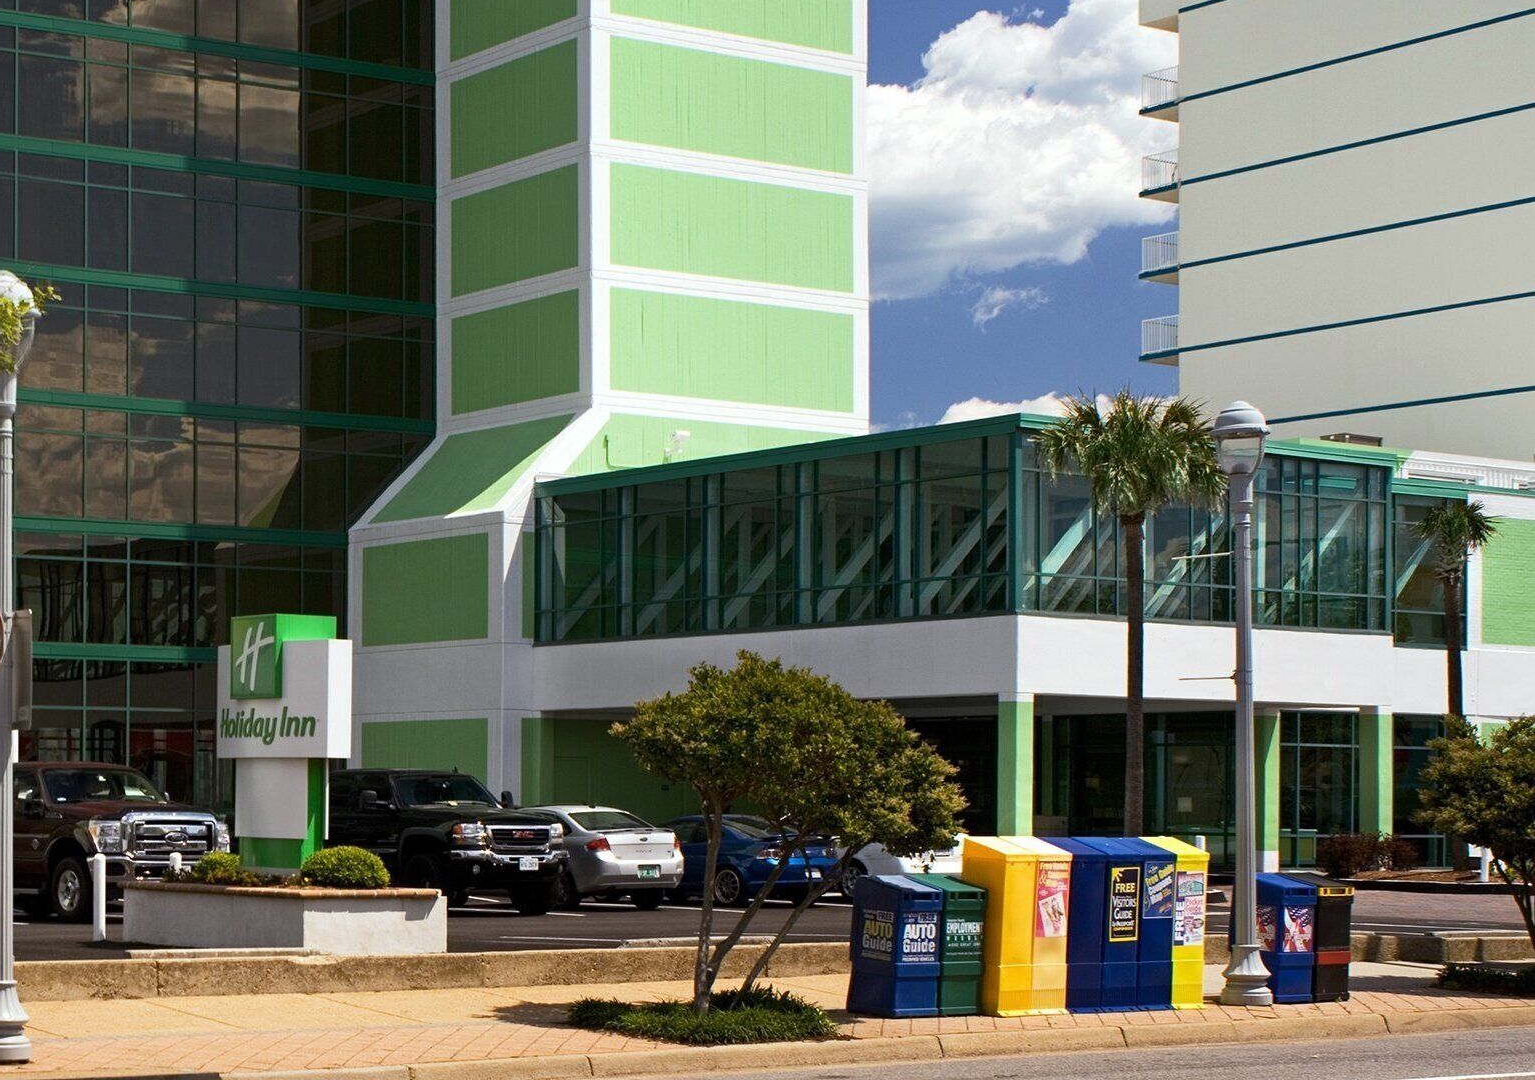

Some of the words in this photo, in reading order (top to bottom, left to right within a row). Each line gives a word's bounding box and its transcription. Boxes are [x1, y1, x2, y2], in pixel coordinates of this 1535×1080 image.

[219, 707, 277, 746] Holiday
[279, 705, 316, 738] Inn
[1114, 882, 1136, 893] FREE
[863, 919, 893, 939] AUTO
[946, 922, 984, 934] EMPLOYMENT
[1174, 901, 1185, 941] FREE
[903, 923, 936, 939] AUTO
[862, 934, 892, 952] Guide
[903, 938, 936, 953] Guide
